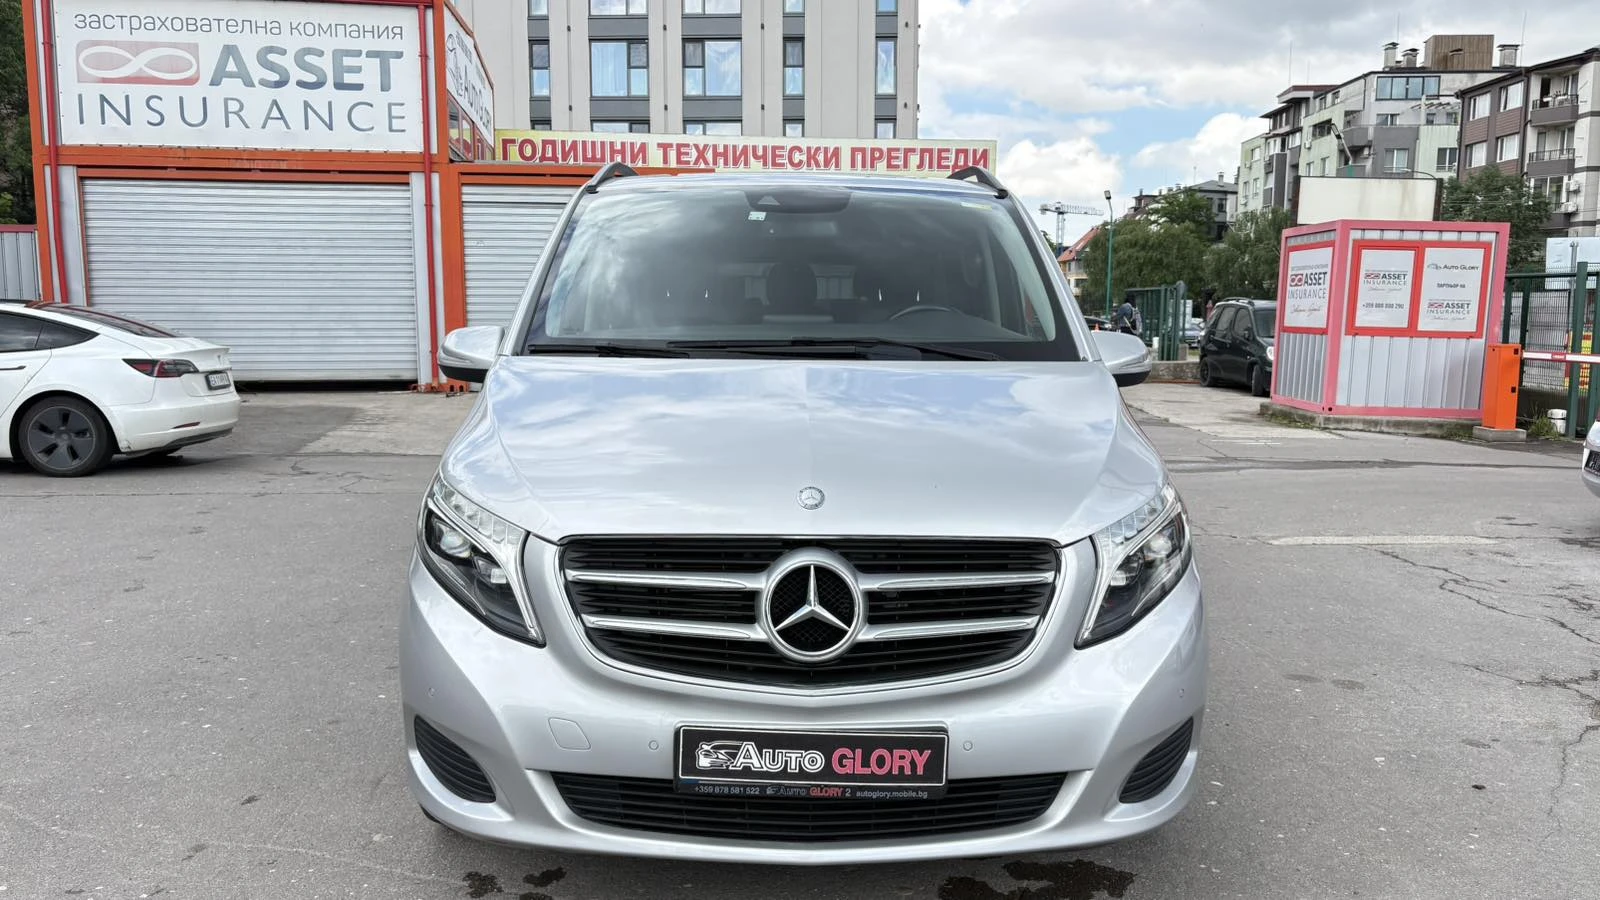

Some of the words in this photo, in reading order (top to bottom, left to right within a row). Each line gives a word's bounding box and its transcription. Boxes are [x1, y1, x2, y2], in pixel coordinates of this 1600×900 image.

[74, 13, 282, 35] застрахователна
[290, 22, 404, 40] компания
[208, 44, 404, 92] ASSET
[77, 93, 406, 133] INSURANCE
[501, 137, 649, 166] ГОДИШНИ
[656, 142, 842, 170] ТЕХНИЧЕСКИ
[850, 146, 990, 172] ПРЕГЛЕДИ
[1303, 271, 1327, 287] ASSET
[1288, 288, 1327, 300] INSURANCE
[831, 747, 932, 775] GLORY
[694, 785, 713, 793] +359
[730, 786, 744, 794] 581
[745, 786, 760, 795] 522
[809, 786, 843, 797] GLORY
[845, 787, 851, 797] 2
[856, 790, 928, 799] autoglory.mobile.bg
